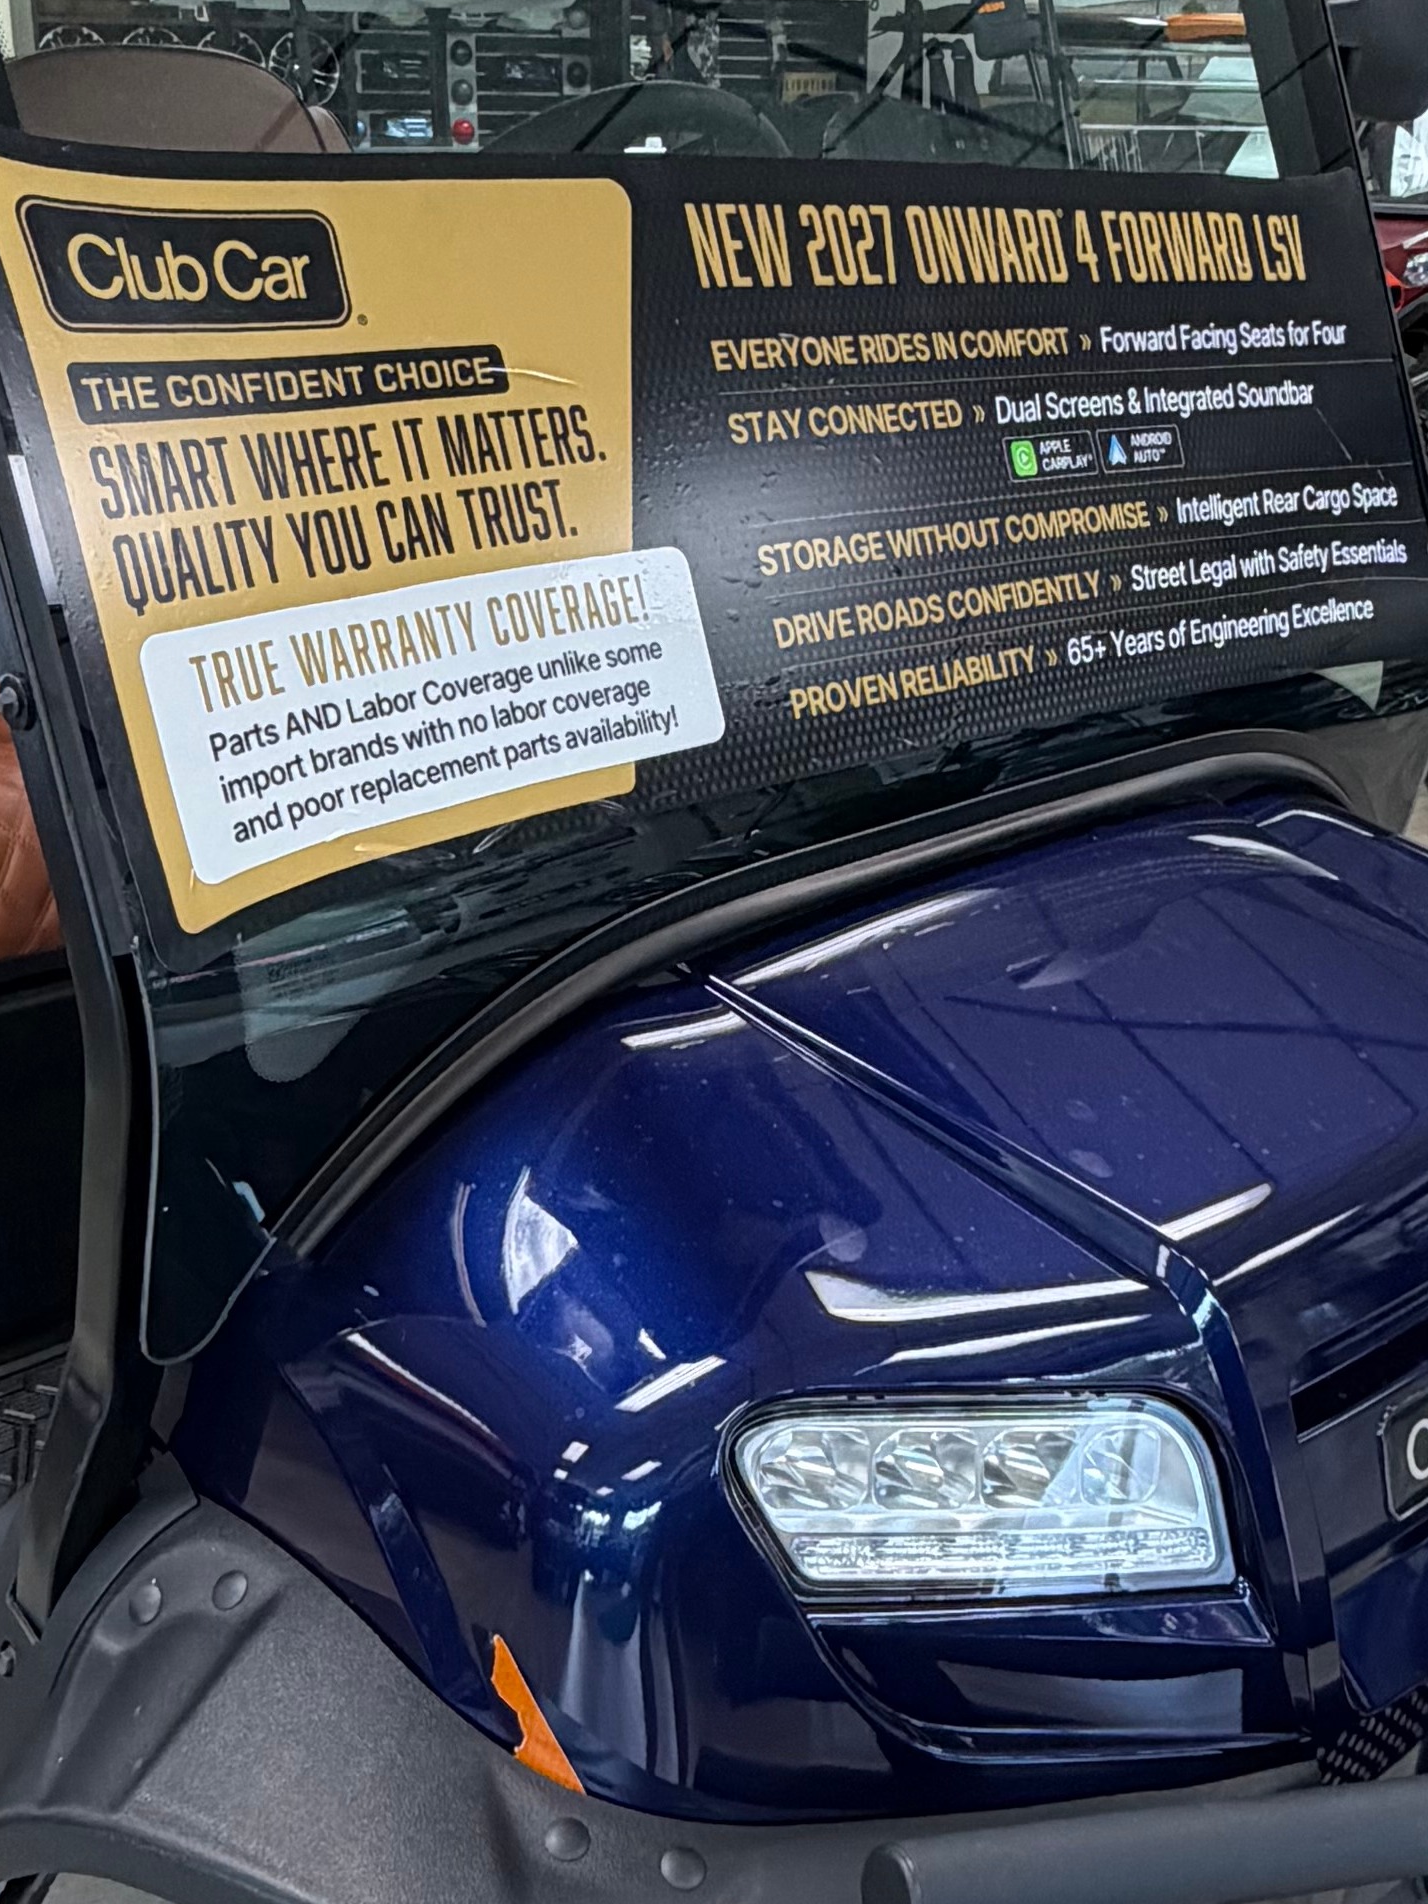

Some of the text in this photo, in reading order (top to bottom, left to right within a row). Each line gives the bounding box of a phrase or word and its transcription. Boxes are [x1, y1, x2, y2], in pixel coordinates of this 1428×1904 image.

[67, 232, 311, 302] Club Car
[684, 202, 793, 289] NEW
[798, 203, 898, 286] 2027
[1074, 209, 1101, 283] 4
[1101, 209, 1254, 284] FORWARD
[1252, 213, 1307, 282] LSV
[710, 326, 1070, 372] EVERYONE RIDES IN COMFORT
[1099, 319, 1348, 356] Forward Facing Seats for Four
[81, 356, 496, 413] THE CONFIDENT CHOICE
[995, 379, 1315, 425] Dual Screens & Integrated Soundbar
[727, 398, 964, 445] STAY CONNECTED
[1039, 438, 1072, 457] APPLE
[89, 403, 608, 521] SMART WHERE IT MATTERS.
[757, 500, 1151, 577] STORAGE WITHOUT COMPROMISE
[1176, 481, 1399, 527] Intelligent Rear Cargo Space
[112, 479, 579, 617] QUALITY YOU CAN TRUST.
[1130, 537, 1408, 593] Street Legal with Safety Essentials
[188, 573, 651, 714] TRUE WARRANTY COVERAGE!
[772, 569, 1100, 651] DRIVE ROADS CONFIDENTLY
[1067, 597, 1375, 667] 65+ Years of Engineering Excellence
[209, 641, 663, 762] Parts AND Labor Coverage unlike some
[789, 645, 1036, 721] PROVEN RELIABILITY
[220, 676, 652, 804] import brands with no labor coverage
[232, 705, 681, 844] and poor replacement parts availability!
